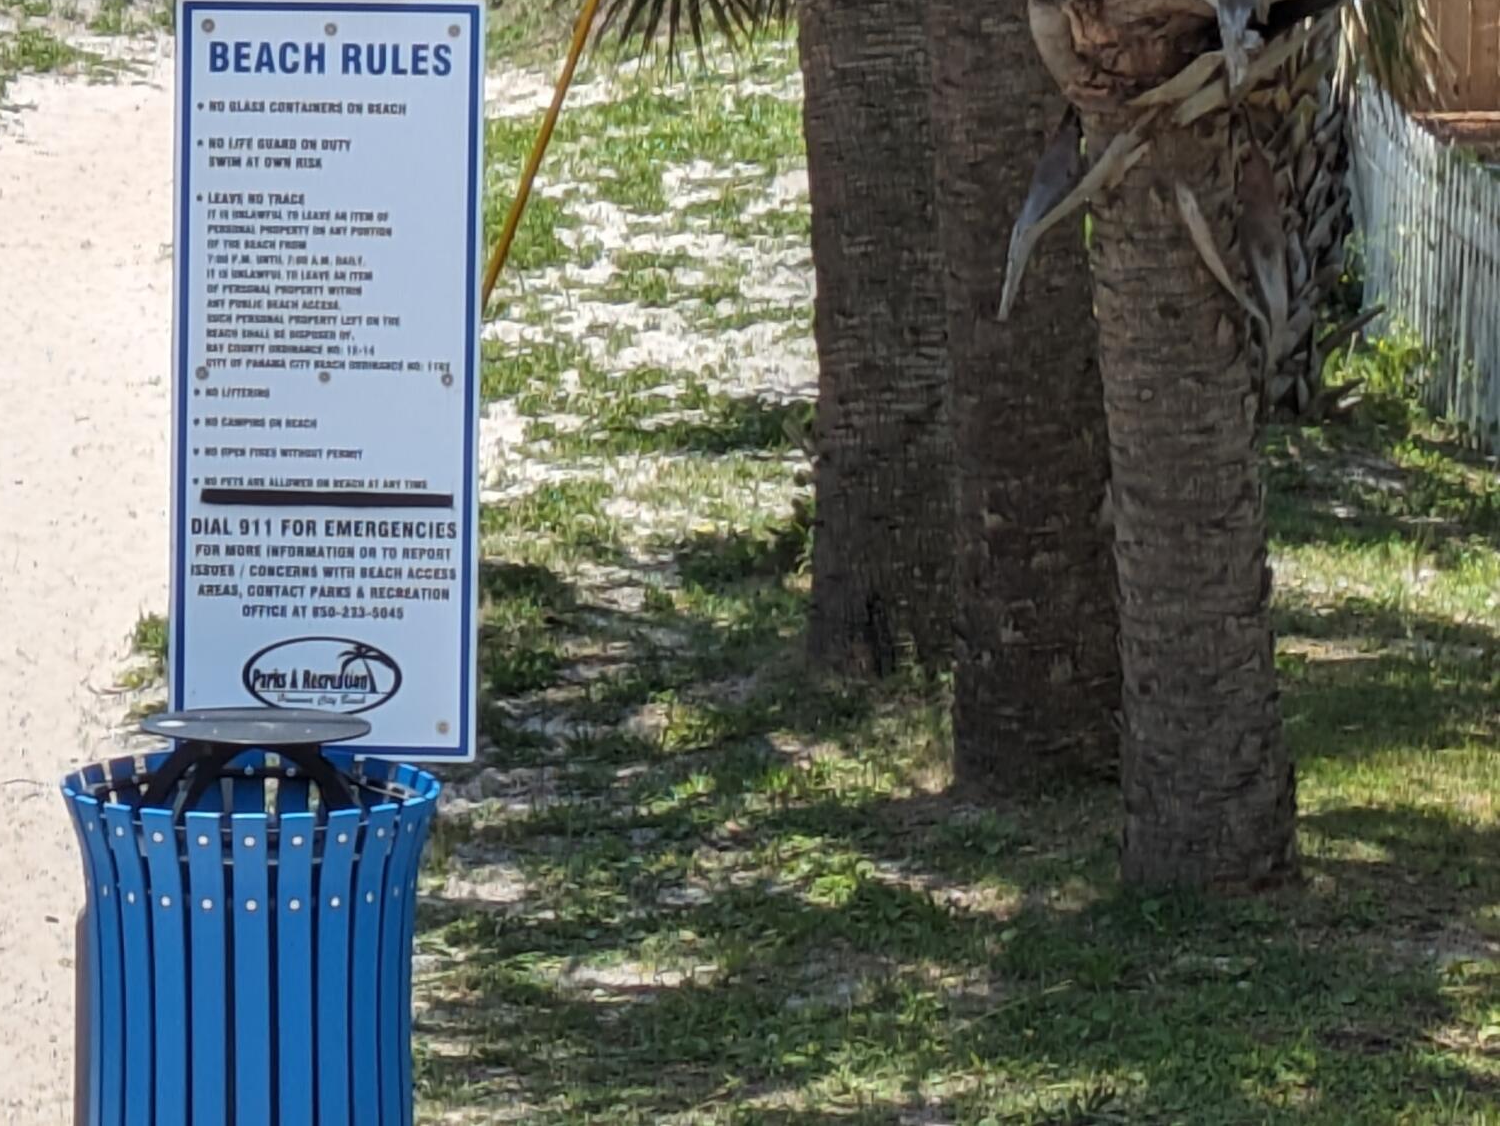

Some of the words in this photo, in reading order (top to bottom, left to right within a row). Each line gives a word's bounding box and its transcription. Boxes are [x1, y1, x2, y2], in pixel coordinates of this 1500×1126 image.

[209, 42, 326, 73] BEACH
[342, 43, 452, 76] RULES
[209, 101, 225, 112] NO
[229, 101, 265, 112] GLASS
[269, 102, 342, 114] CONTAINERS
[347, 103, 363, 114] ON
[368, 103, 406, 115] BEACH
[209, 138, 224, 149] NO
[229, 138, 253, 149] LIFE
[257, 139, 296, 150] GUARD
[301, 139, 317, 150] ON
[322, 139, 351, 151] DUTY
[209, 157, 241, 167] SWIM
[246, 157, 259, 167] AT
[265, 157, 291, 168] OWN
[296, 158, 322, 169] RISK
[208, 193, 243, 204] LEAVE
[248, 194, 263, 204] NO
[269, 194, 305, 205] TRACE
[302, 211, 330, 220] LEAVE
[206, 388, 218, 397] NO
[222, 388, 270, 398] LITTERING
[205, 418, 217, 426] NO
[221, 418, 265, 427] CAMPING
[285, 419, 317, 429] BEACH
[205, 447, 217, 456] NO
[281, 449, 323, 458] WITHOUT
[205, 478, 217, 486] NO
[221, 478, 244, 486] PETS
[269, 478, 313, 487] ALLOWED
[333, 479, 364, 488] BEACH
[368, 480, 379, 488] AT
[383, 480, 401, 488] ANY
[191, 518, 232, 535] DIAL
[239, 519, 272, 536] 911
[281, 519, 316, 537] FOR
[325, 521, 457, 539] EMERGENCIES
[195, 544, 220, 556] FOR
[225, 545, 261, 557] MORE
[267, 545, 354, 558] INFORMATION
[360, 547, 376, 558] OR
[382, 547, 397, 559] TO
[402, 547, 451, 560] REPORT
[190, 565, 235, 577] ISSUES
[249, 565, 318, 578] CONCERNS
[323, 567, 354, 578] WITH
[360, 567, 402, 579] BEACH
[407, 568, 456, 580] ACCESS
[198, 585, 242, 598] AREAS,
[248, 585, 305, 598] CONTACT
[310, 586, 350, 598] PARKS
[370, 587, 450, 601] RECREATION
[242, 605, 287, 617] OFFICE
[292, 606, 306, 618] AT
[253, 668, 287, 690] Parks
[303, 668, 367, 690] Recreation
